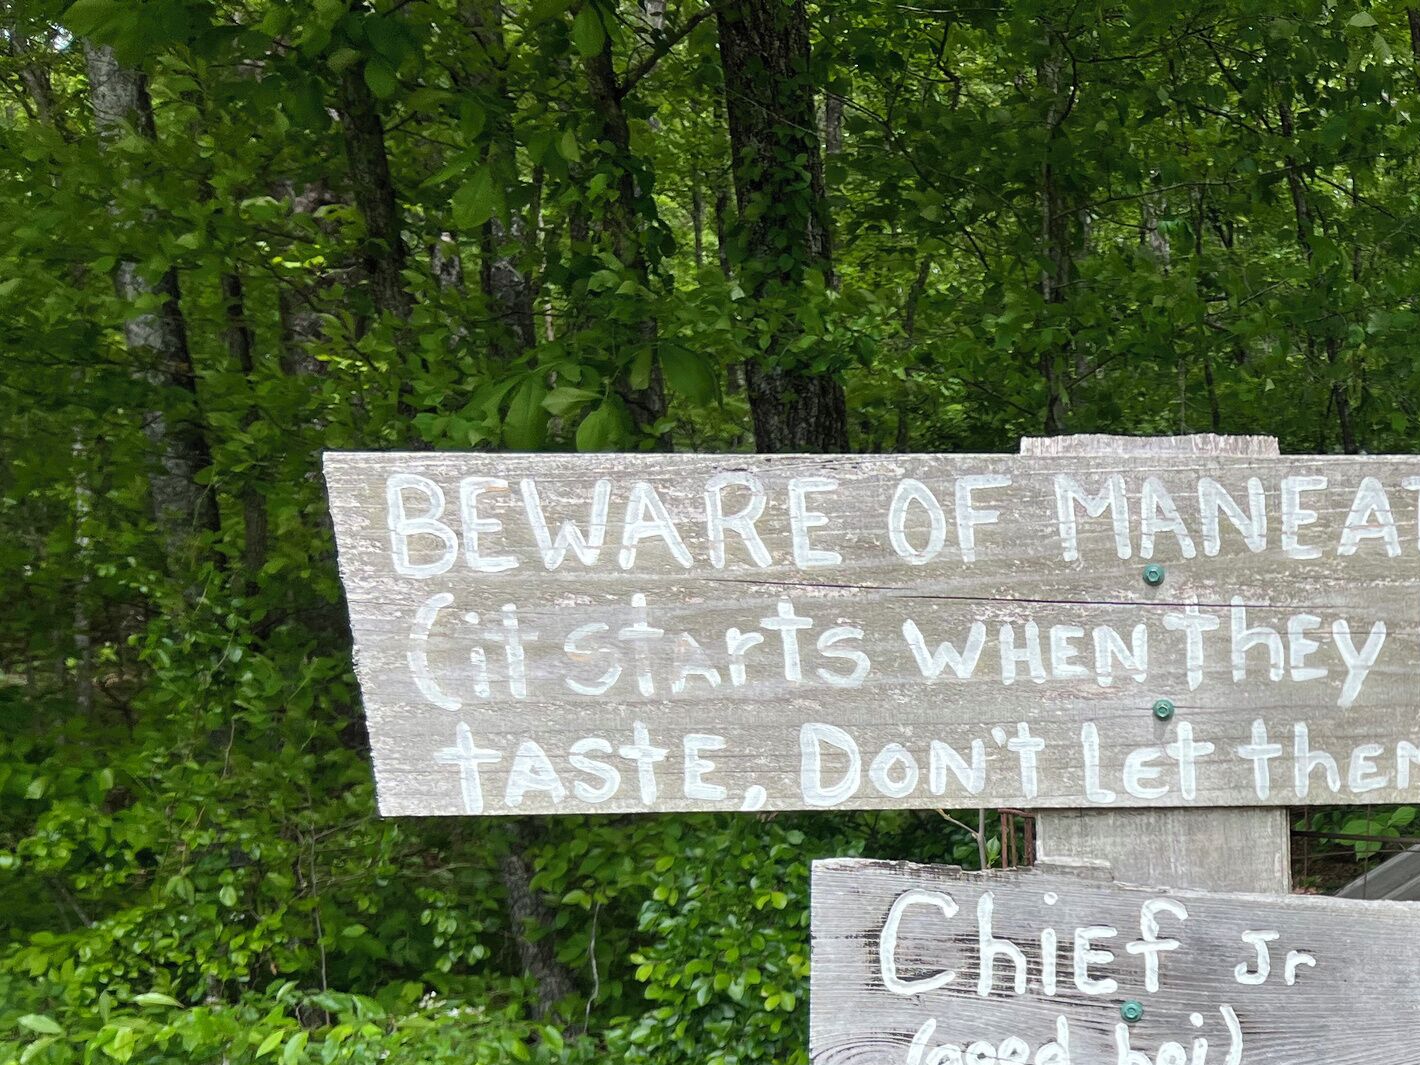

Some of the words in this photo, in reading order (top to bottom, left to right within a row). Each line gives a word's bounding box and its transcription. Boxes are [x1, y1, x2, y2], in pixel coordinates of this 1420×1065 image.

[386, 472, 843, 579] BEWARE
[888, 473, 1012, 565] OF
[1234, 929, 1317, 986] Jr
